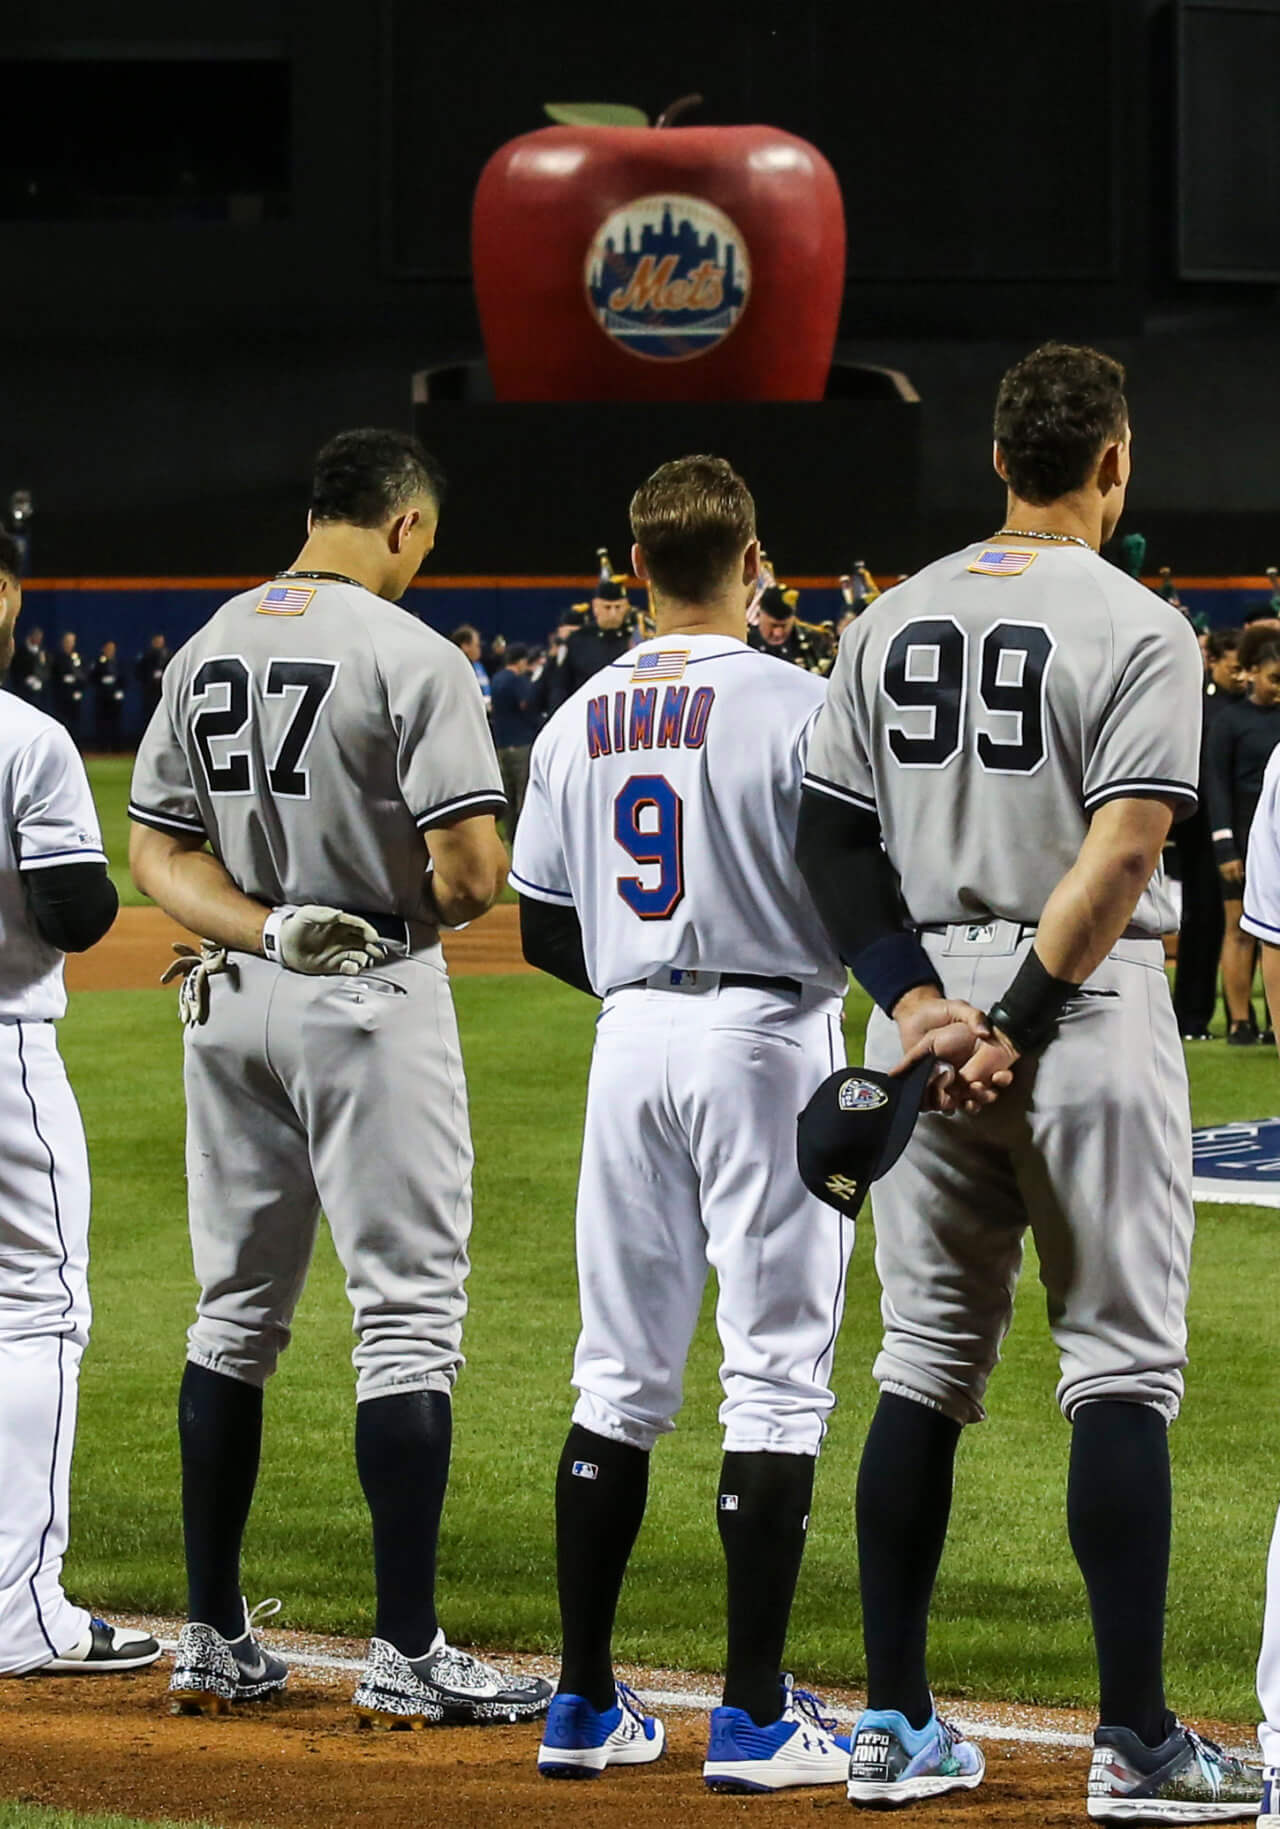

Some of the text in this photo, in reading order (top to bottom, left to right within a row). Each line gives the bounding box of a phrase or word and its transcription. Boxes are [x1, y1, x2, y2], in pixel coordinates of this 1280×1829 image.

[608, 255, 726, 311] Mets
[587, 686, 715, 759] NIMMO
[880, 614, 1057, 775] 99
[191, 654, 340, 800] 27
[614, 774, 686, 921] 9
[824, 1174, 857, 1201] NY
[854, 1745, 889, 1763] FDNY
[856, 1733, 890, 1746] NYPD
